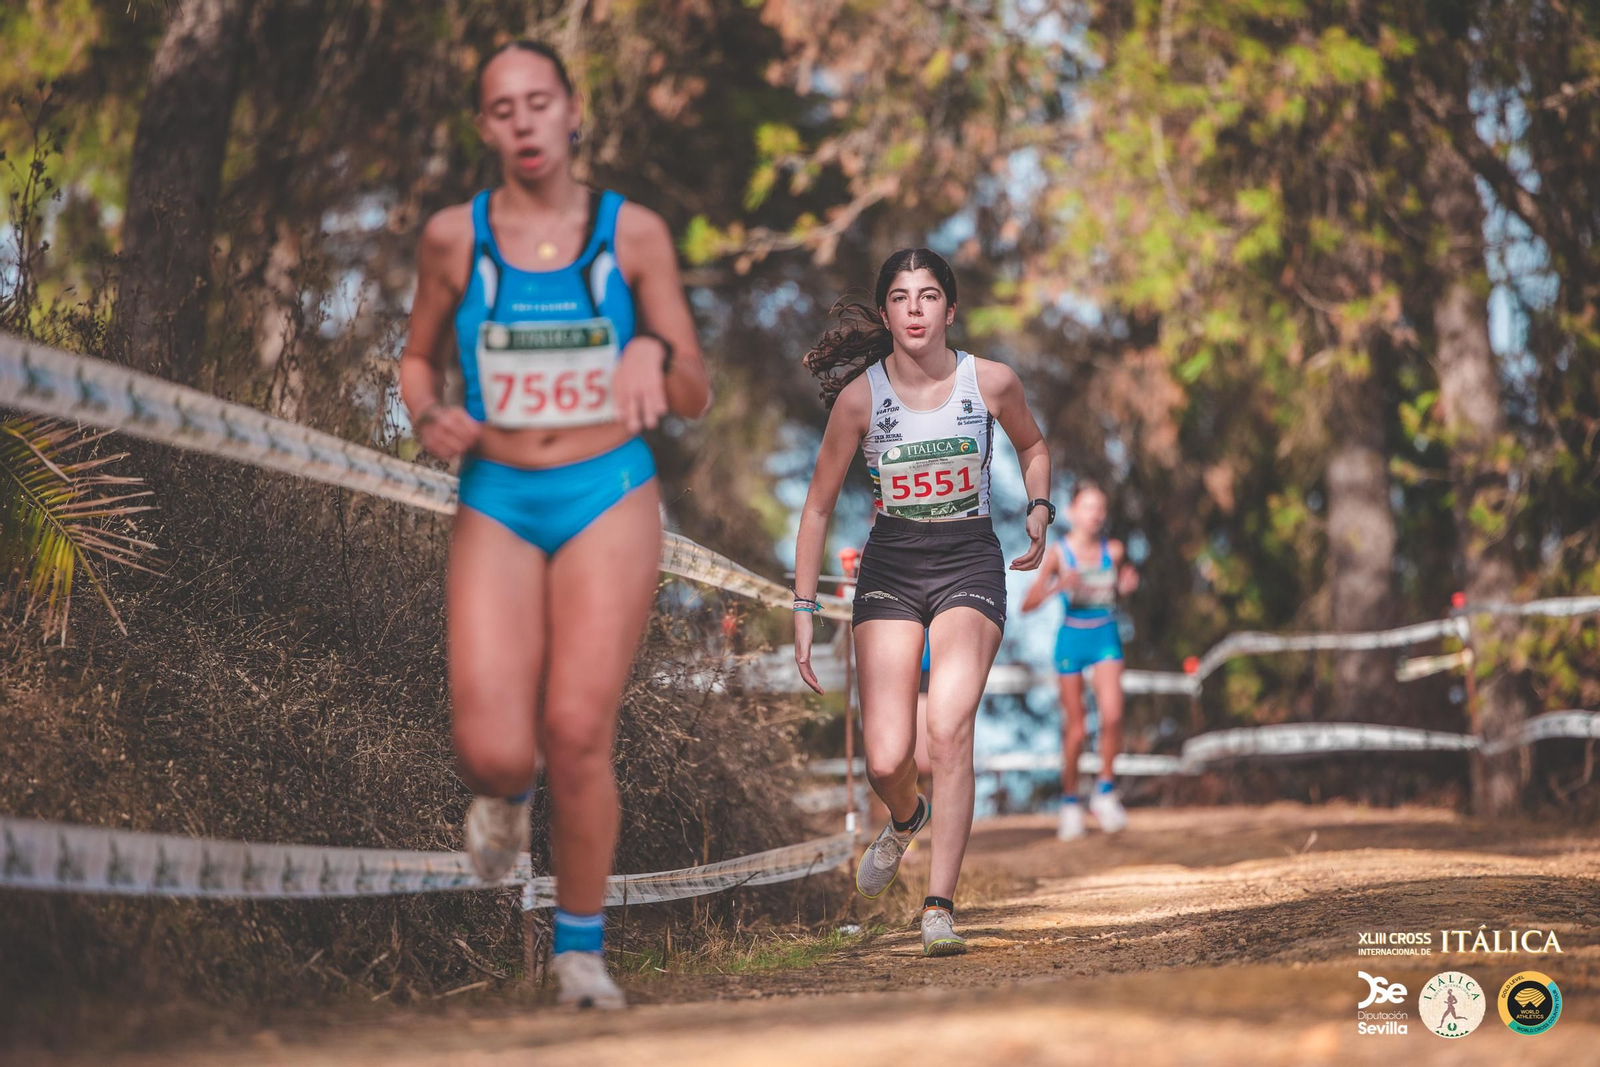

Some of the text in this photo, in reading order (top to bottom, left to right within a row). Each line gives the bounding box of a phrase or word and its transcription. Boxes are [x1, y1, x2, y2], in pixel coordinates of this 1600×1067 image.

[492, 368, 608, 416] 7565
[876, 406, 900, 416] VIATOR
[907, 441, 954, 456] ITÁLICA
[892, 466, 975, 500] 5551
